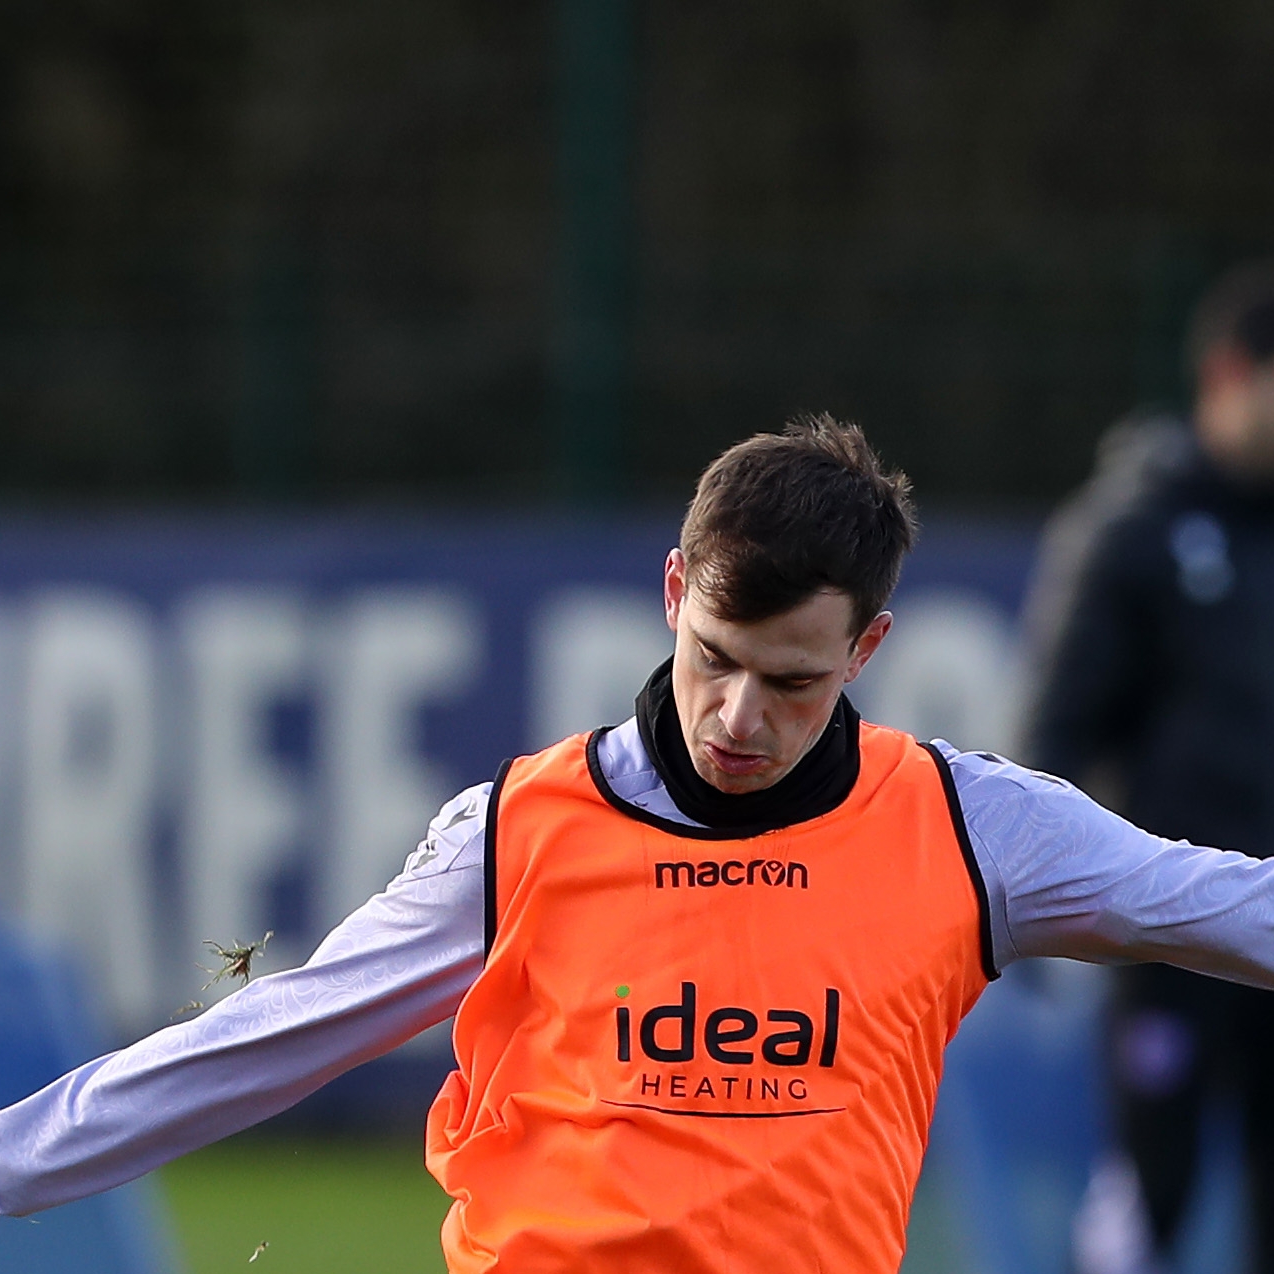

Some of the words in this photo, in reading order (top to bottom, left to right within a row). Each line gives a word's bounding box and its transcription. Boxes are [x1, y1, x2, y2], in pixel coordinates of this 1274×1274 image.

[654, 859, 809, 890] macron
[615, 981, 841, 1068] ideal
[640, 1073, 808, 1100] HEATING
